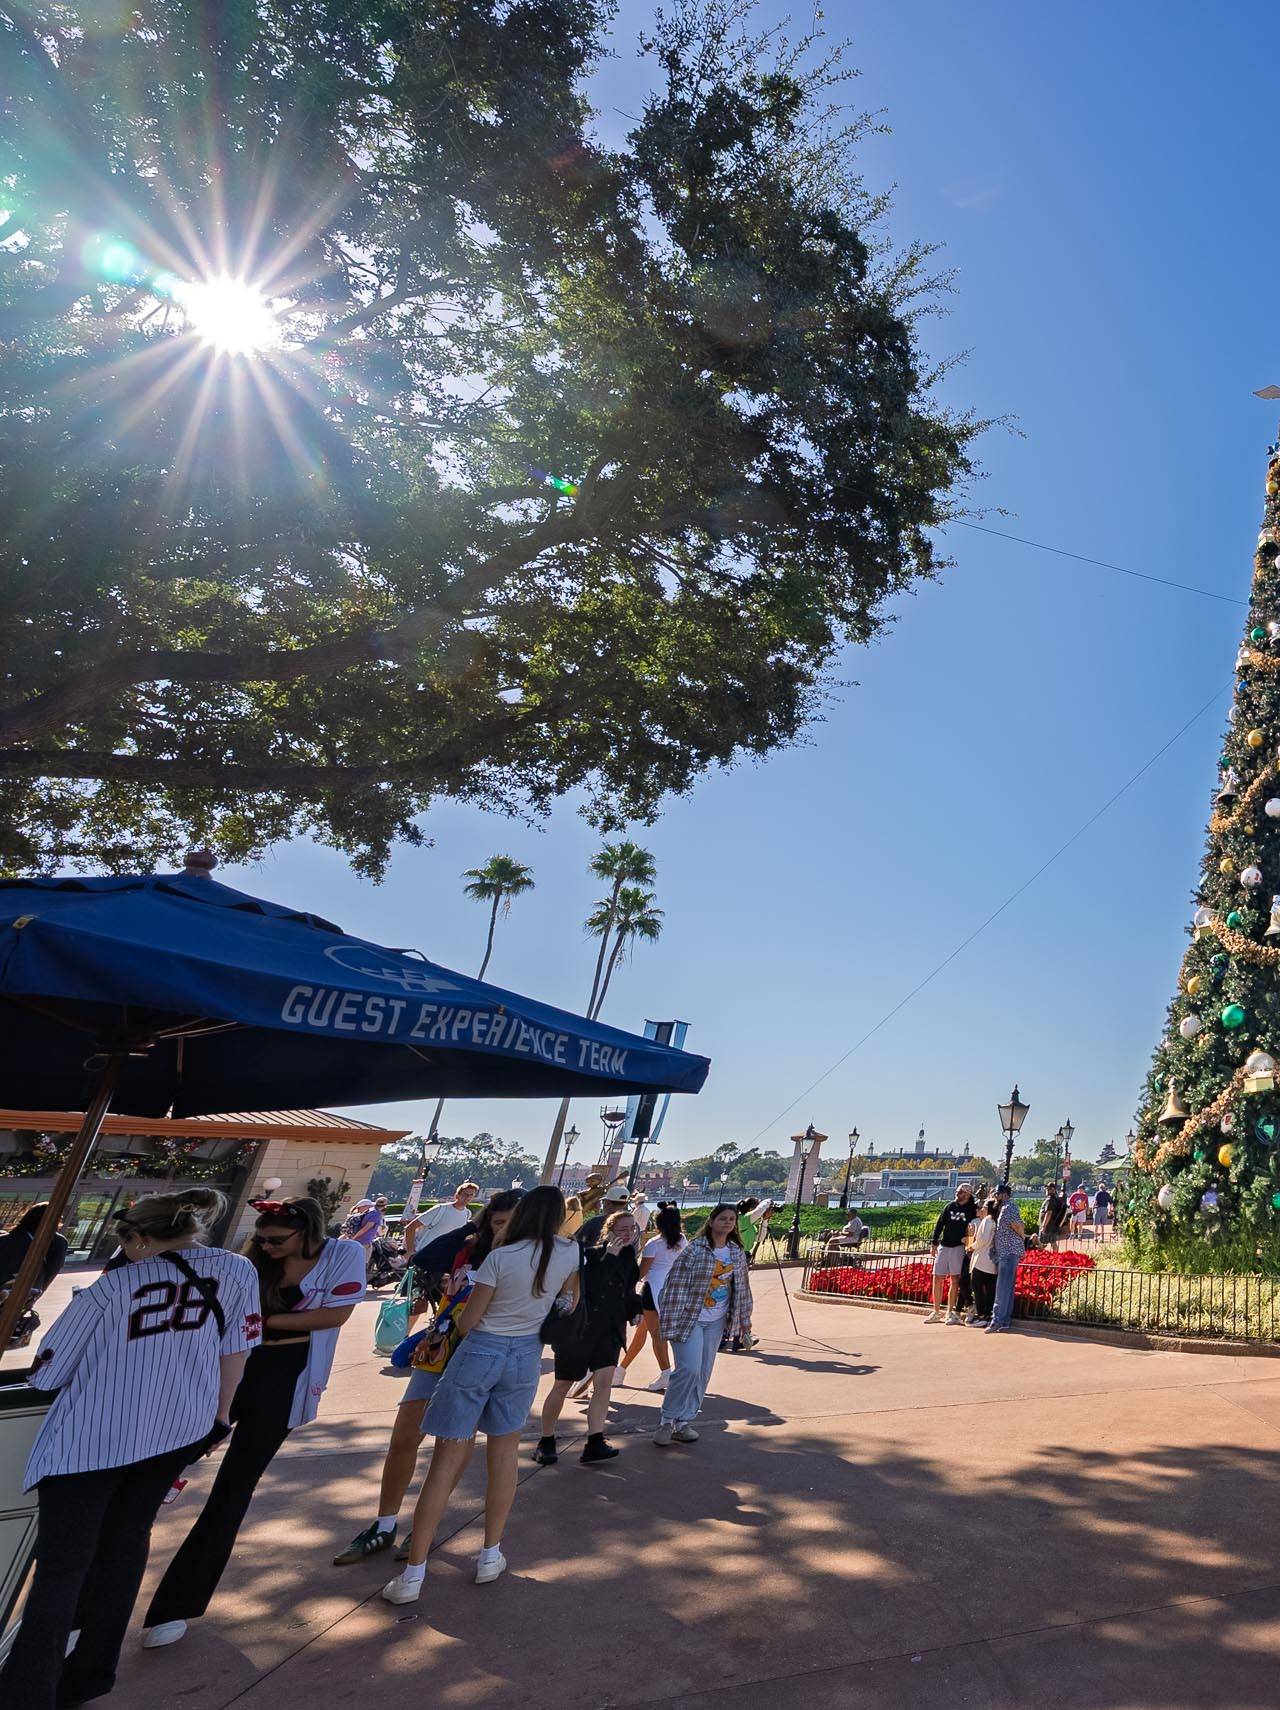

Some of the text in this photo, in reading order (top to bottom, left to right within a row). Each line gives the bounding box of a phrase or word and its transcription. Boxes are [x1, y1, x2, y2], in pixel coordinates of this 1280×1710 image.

[281, 985, 629, 1075] GUEST EXPERIENCE TEAM
[128, 1277, 219, 1341] 28
